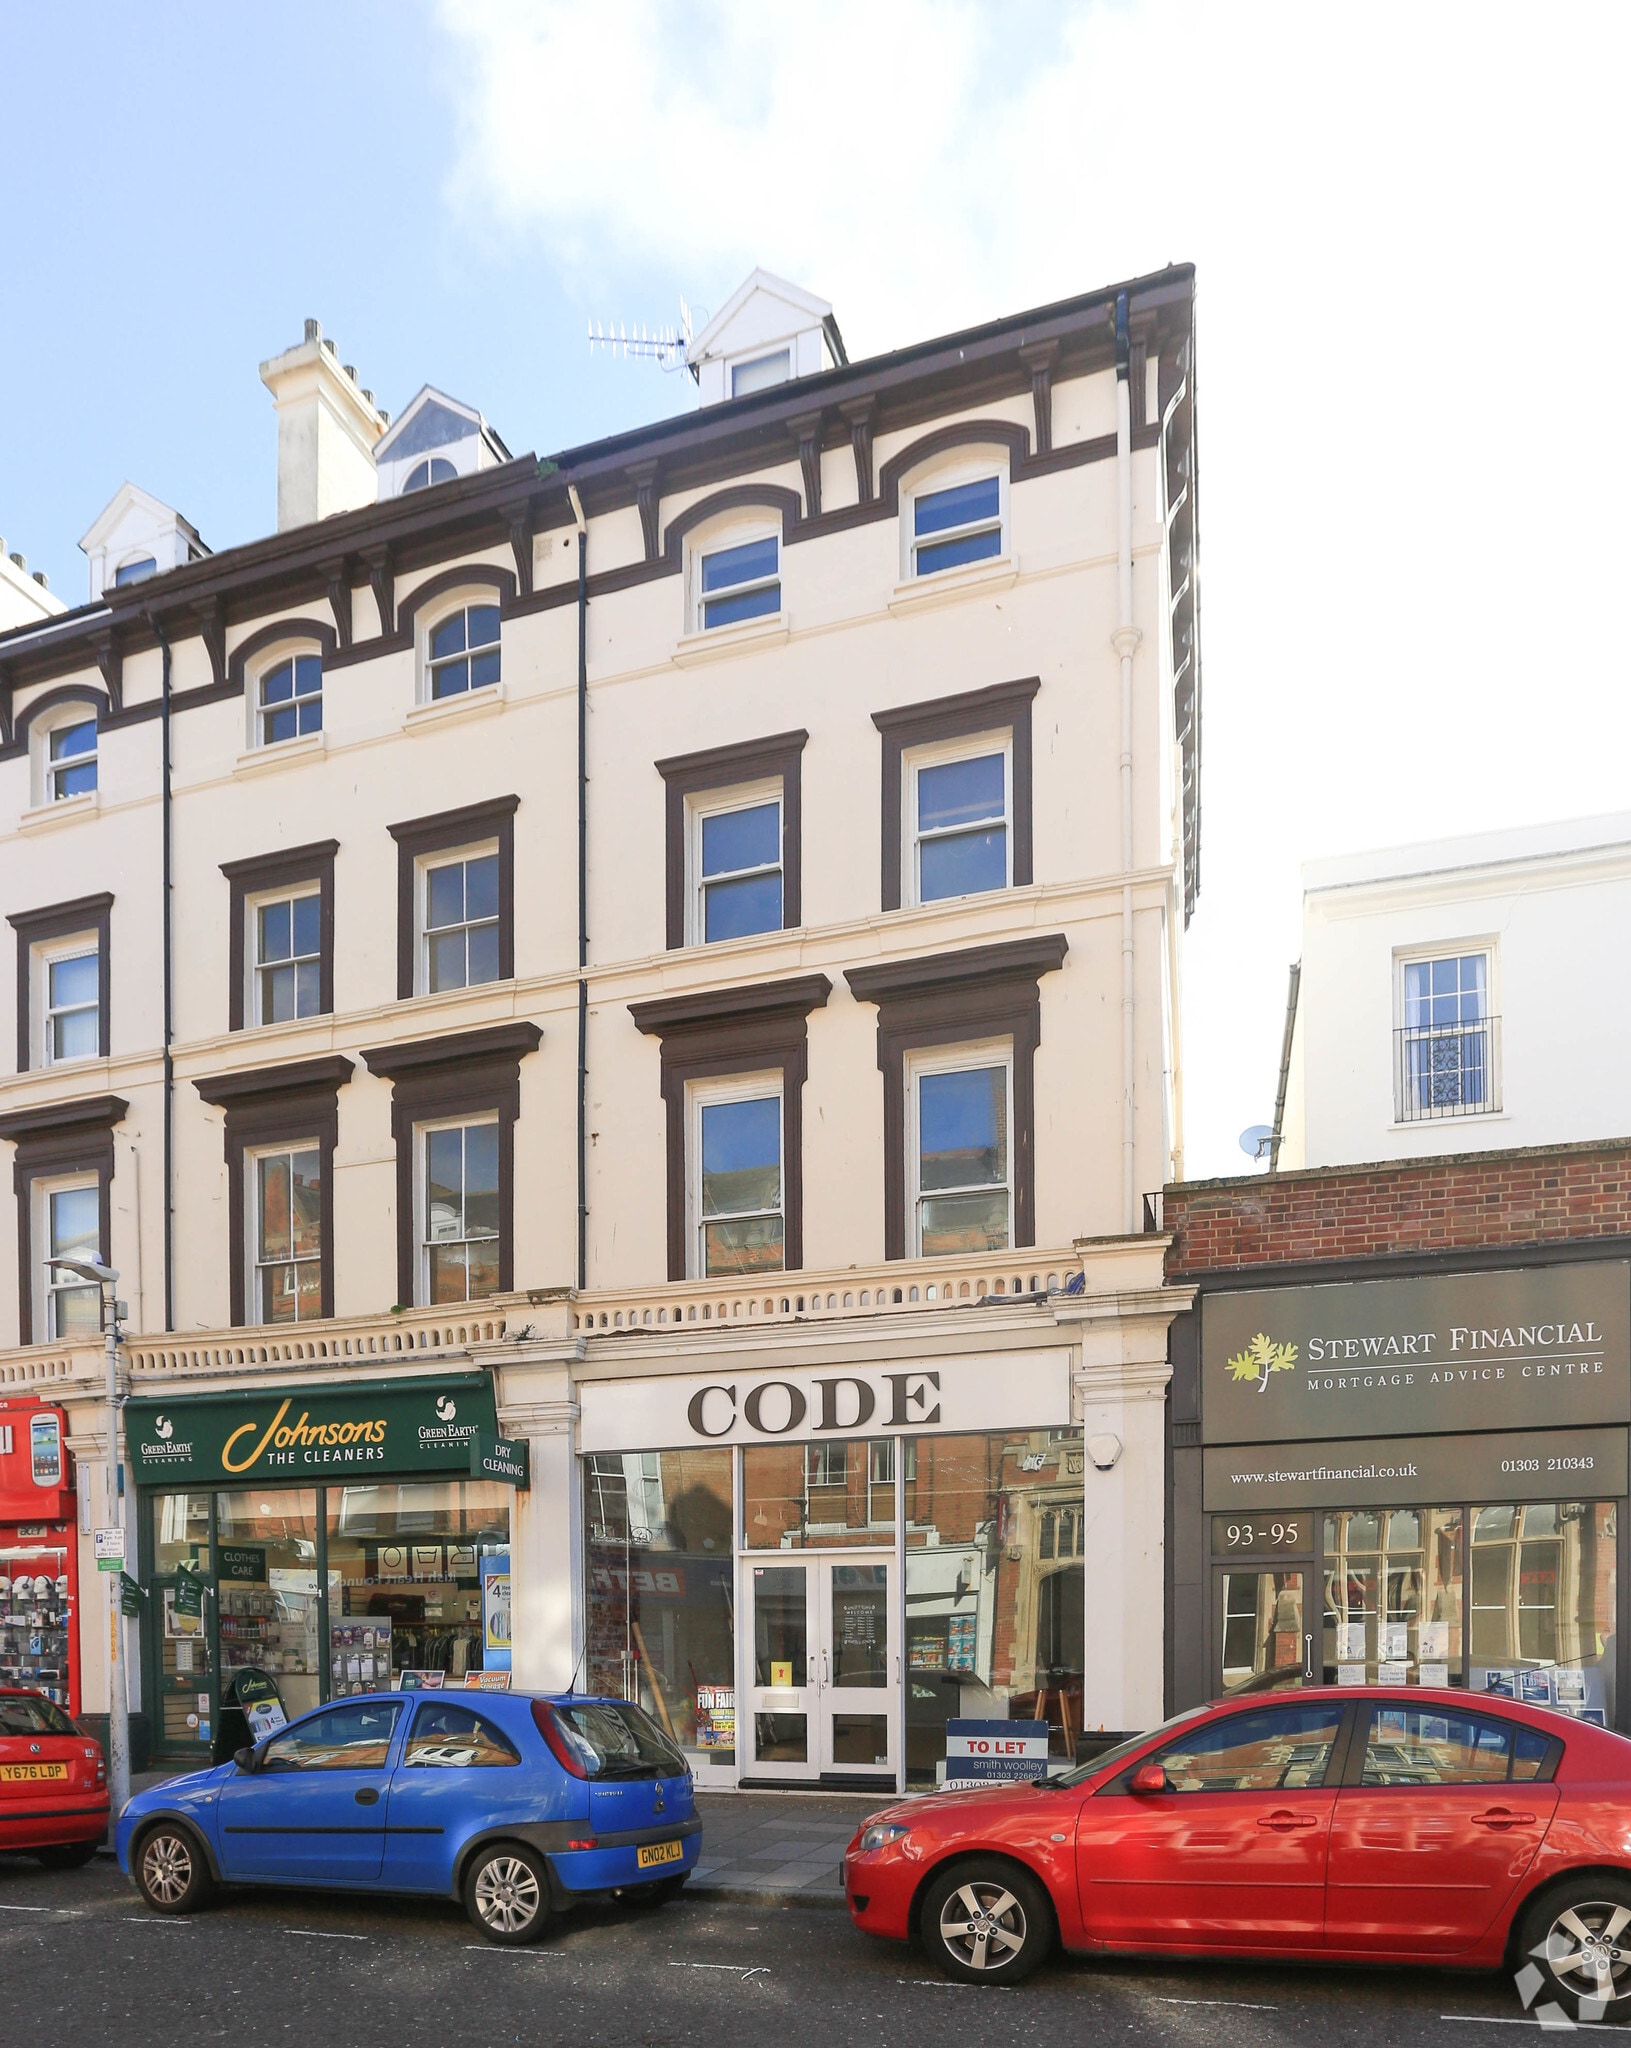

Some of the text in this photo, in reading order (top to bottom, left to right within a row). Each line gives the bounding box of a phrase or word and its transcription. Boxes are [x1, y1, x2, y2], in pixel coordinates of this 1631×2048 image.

[1307, 1321, 1604, 1361] STEWART FINANCIAL
[1307, 1361, 1604, 1391] MORTGAGE ADVICE CENTRE
[686, 1371, 941, 1438] CODE
[221, 1398, 388, 1473] Johnsons
[419, 1440, 469, 1450] CLEANIN
[495, 1444, 512, 1459] DRY
[143, 1456, 193, 1465] CLEANING
[267, 1446, 385, 1465] THE CLEANERS
[482, 1457, 524, 1477] CLEANING
[1501, 1457, 1595, 1472] 01303 210343
[1230, 1462, 1419, 1484] www.stewartfinancial.co.uk
[223, 1551, 260, 1563] CLOTHES
[231, 1565, 253, 1576] CARE
[492, 1584, 501, 1598] 4
[480, 1676, 506, 1684] Vacuum
[697, 1692, 735, 1709] FUN FAIR
[967, 1740, 1027, 1754] TO LET
[5, 1765, 62, 1779] Y676 LDP
[973, 1760, 1043, 1772] smith woolley
[986, 1771, 1043, 1780] 01303 226622
[641, 1842, 681, 1864] GN02 KLJ
